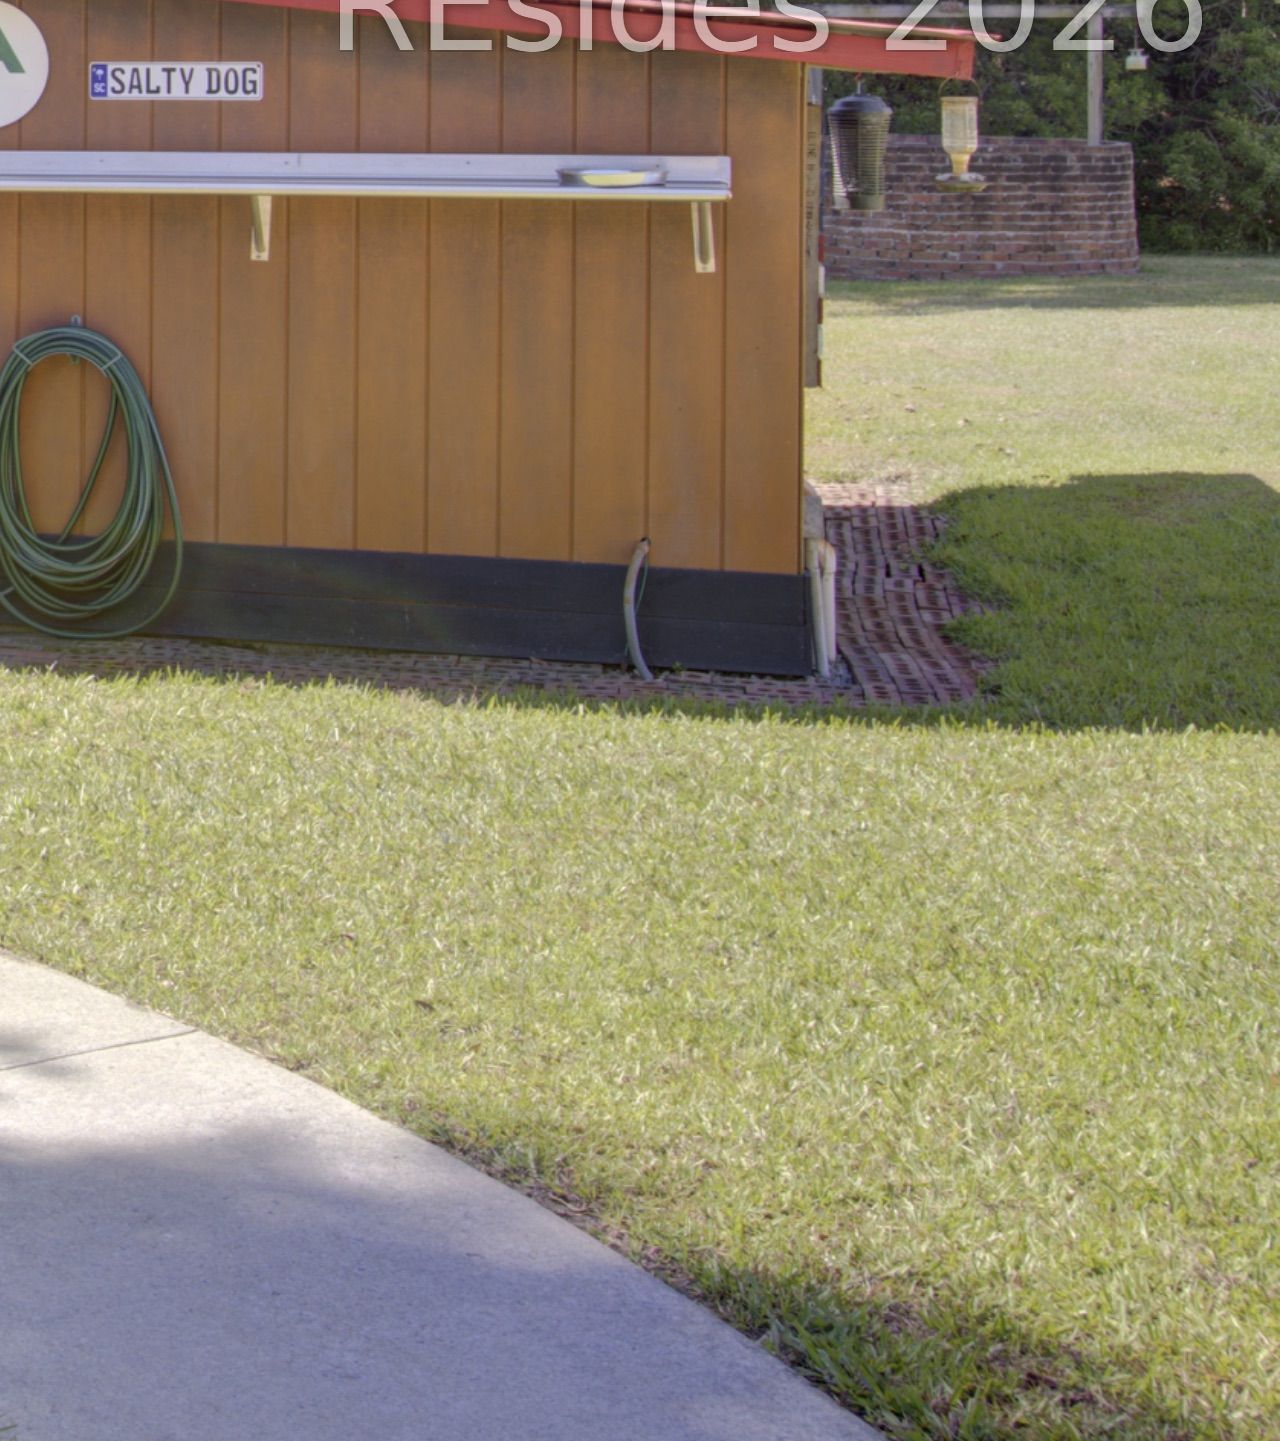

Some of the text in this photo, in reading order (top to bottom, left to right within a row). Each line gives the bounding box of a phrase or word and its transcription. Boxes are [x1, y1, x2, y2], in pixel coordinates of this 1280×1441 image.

[93, 82, 106, 93] SC
[110, 67, 258, 95] SALTY DOG
